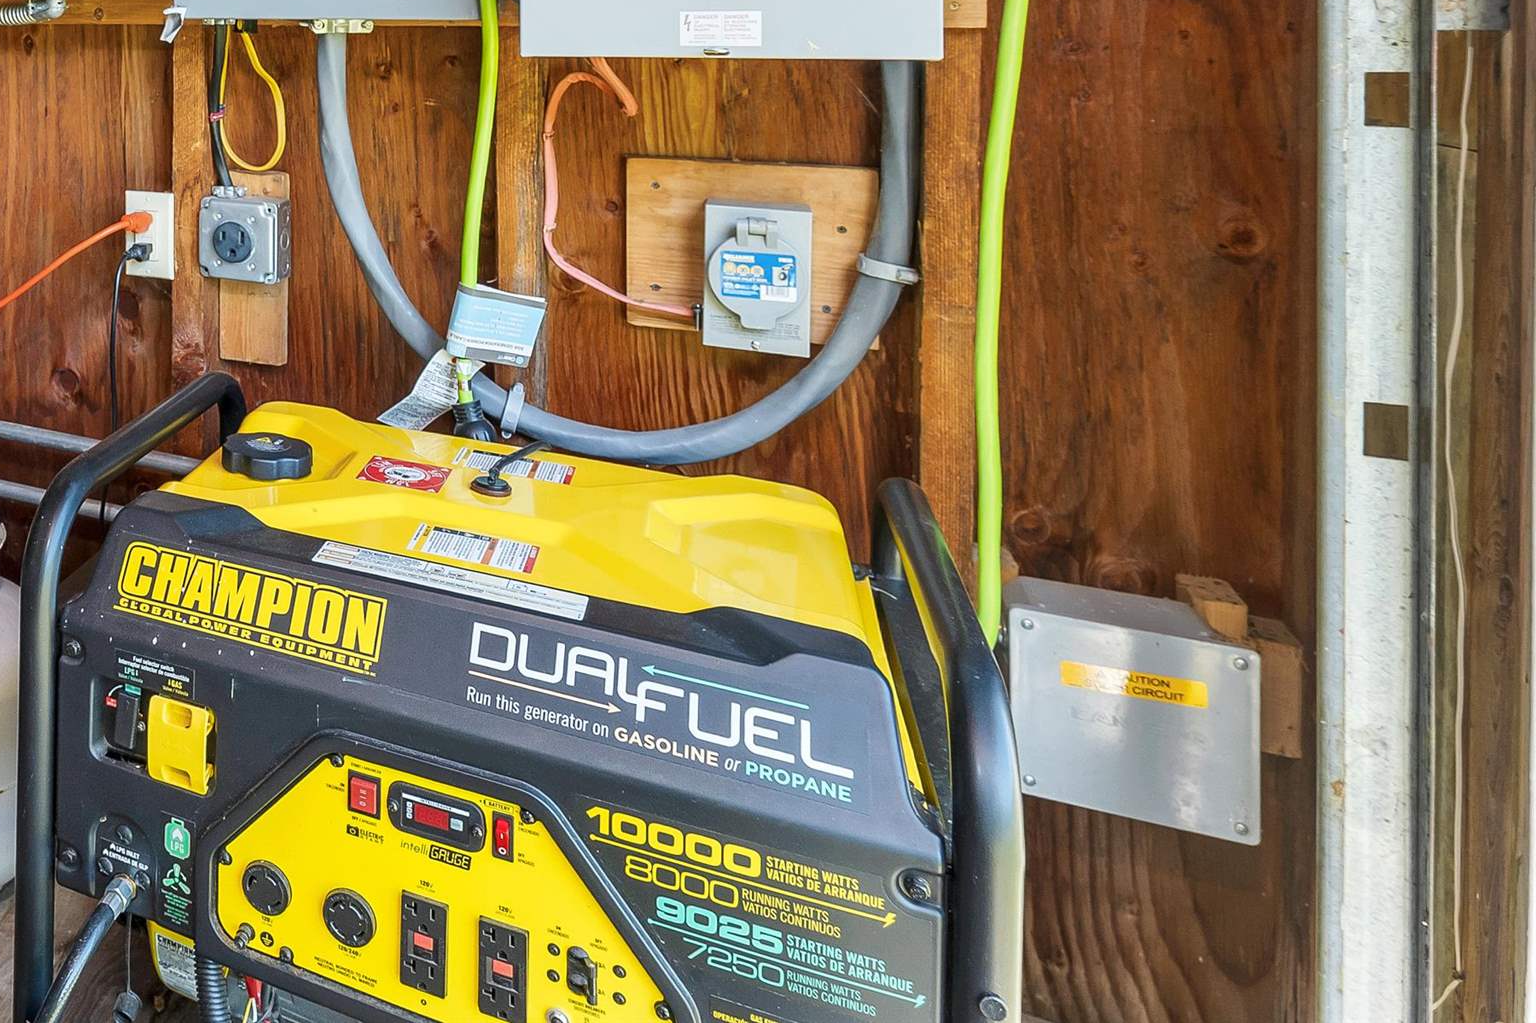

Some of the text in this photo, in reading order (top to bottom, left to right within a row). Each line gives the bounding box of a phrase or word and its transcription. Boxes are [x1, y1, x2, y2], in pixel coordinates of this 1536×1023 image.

[120, 543, 383, 656] CHAMPION
[118, 597, 373, 672] GLOBAL POWER EQUIPMENT
[124, 666, 135, 676] LPG
[132, 655, 143, 664] Fuel
[142, 659, 160, 668] selector
[171, 679, 183, 689] GAS
[1132, 686, 1185, 702] CIRCUIT
[466, 685, 853, 803] Run this generator on GASOLINE or PROPANE
[487, 800, 511, 812] BATTERY
[116, 844, 140, 860] LPG INLET
[170, 839, 184, 854] LPG
[359, 828, 385, 842] ELECTRIC
[585, 806, 860, 891] 10000 STARTING WATTS
[108, 851, 131, 865] ENTRADA
[130, 861, 138, 869] DE
[625, 854, 830, 924] 8000 RUNNING WATTS
[765, 868, 886, 911] VATIOS DE ARRANQUE
[655, 895, 886, 973] 9025 STARTING WATTS
[742, 900, 842, 939] VATIOS CONTINUOS
[682, 936, 862, 1001] 7250 RUNNING WATTS
[786, 945, 914, 994] VATIOS DE ARRANQUE
[786, 981, 877, 1017] VATIOS CONTINUOS
